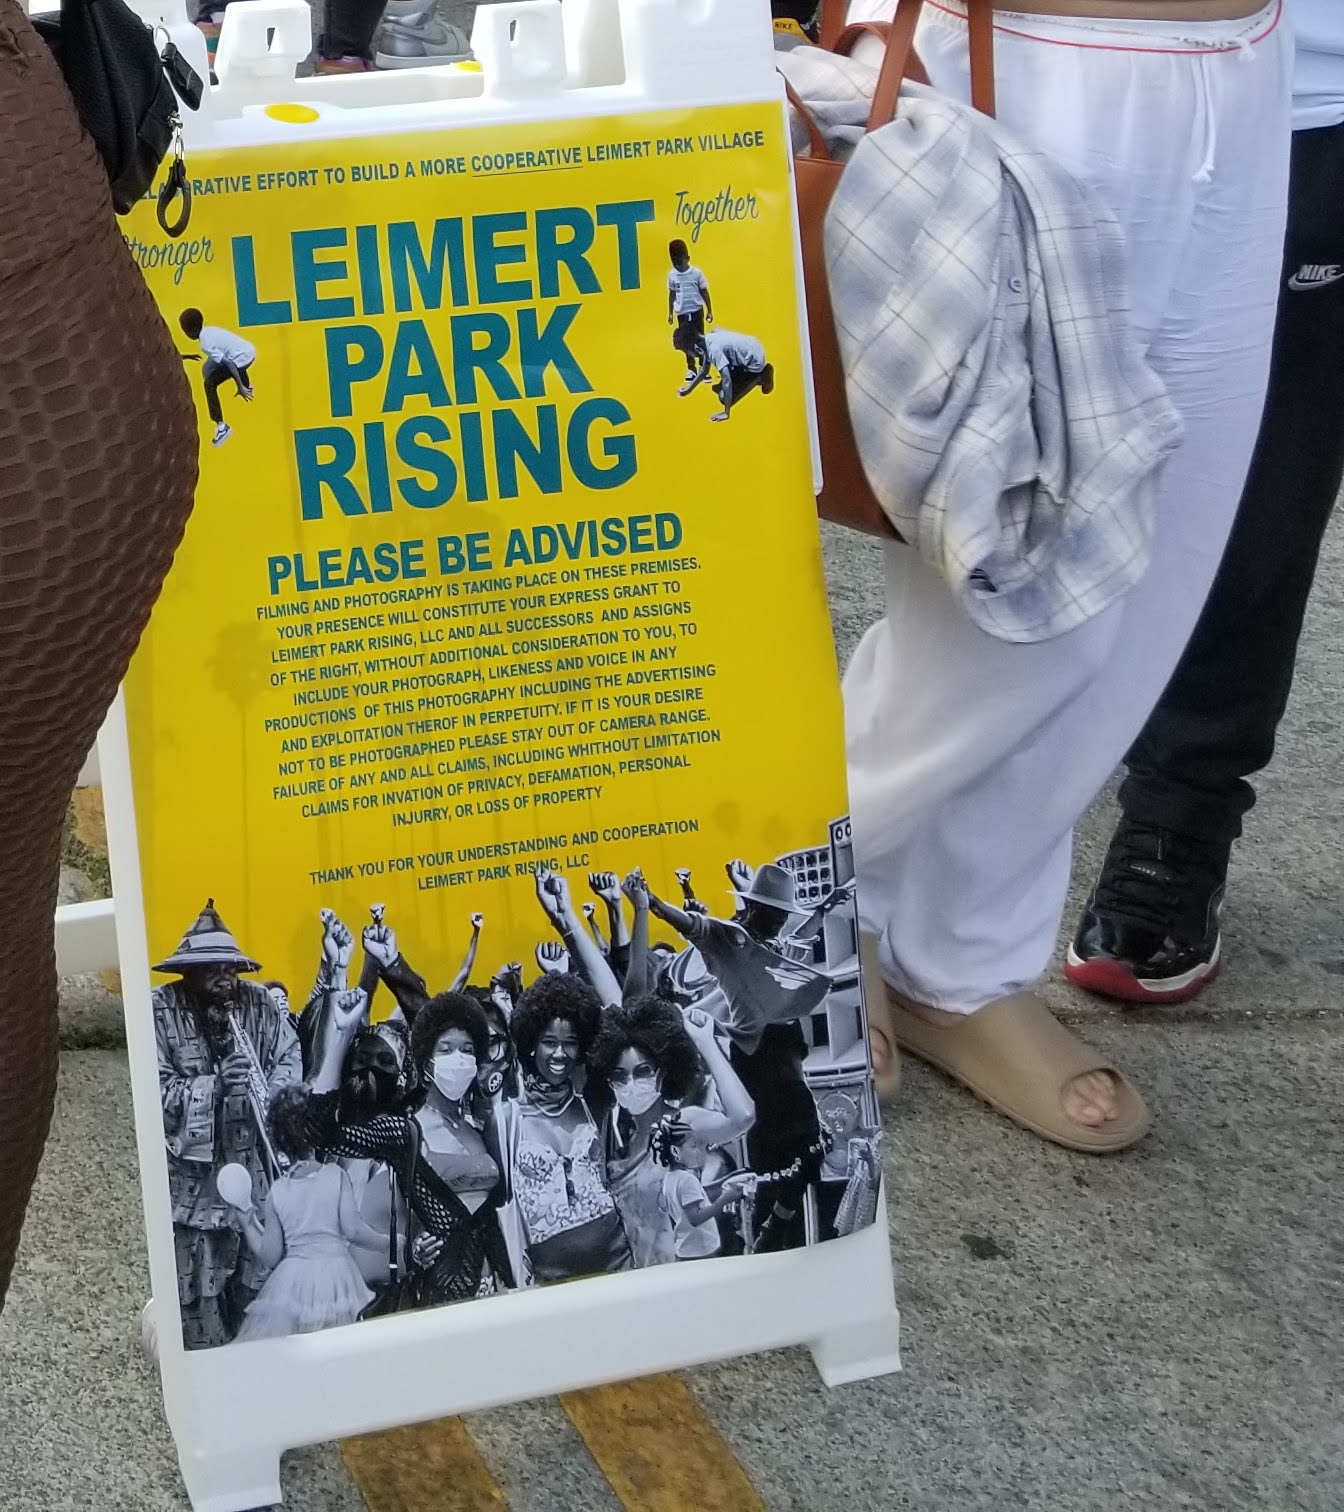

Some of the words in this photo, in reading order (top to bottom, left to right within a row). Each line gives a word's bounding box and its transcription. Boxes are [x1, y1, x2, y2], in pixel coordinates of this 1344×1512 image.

[256, 169, 318, 190] EFFORT
[323, 167, 345, 184] TO
[350, 162, 399, 182] BUILD
[404, 161, 415, 177] A
[420, 156, 466, 176] MORE
[471, 146, 582, 171] COOPERATIVE
[586, 140, 650, 162] LEIMERT
[656, 136, 694, 155] PARK
[697, 130, 764, 151] VILLAGE
[674, 185, 759, 244] Together
[231, 199, 655, 327] LEIMERT
[1297, 264, 1341, 280] NIKE
[324, 303, 594, 417] PARK
[293, 397, 637, 520] RISING
[267, 539, 426, 595] PLEASE
[437, 531, 492, 575] BE
[503, 512, 682, 567] ADVISED
[256, 601, 309, 620] FILMING
[313, 597, 339, 612] AND
[344, 585, 442, 608] PHOTOGRAPHY
[446, 583, 459, 596] IS
[462, 577, 512, 594] TAKING
[515, 571, 557, 588] PLACE
[560, 568, 580, 582] ON
[582, 564, 626, 580] THESE
[630, 556, 701, 575] PREMISES.
[276, 623, 313, 639] YOUR
[316, 613, 384, 634] PRESENCE
[387, 610, 420, 625] WILL
[422, 599, 506, 621] CONSTITUTE
[509, 594, 546, 610] YOUR
[549, 587, 609, 606] EXPRESS
[612, 582, 658, 599] GRANT
[662, 580, 680, 593] TO
[270, 671, 286, 686] OF
[289, 667, 316, 683] THE
[319, 661, 361, 679] RIGHT,
[364, 653, 425, 673] WITHOUT
[429, 643, 508, 664] ADDITIONAL
[511, 630, 618, 654] CONSIDERATION
[621, 628, 640, 641] TO
[643, 624, 676, 639] YOU,
[678, 622, 697, 635] TO
[271, 643, 326, 663] LEIMERT
[330, 638, 364, 655] PARK
[368, 632, 416, 649] RISING,
[419, 628, 444, 643] LLC
[448, 625, 474, 640] AND
[478, 622, 502, 636] ALL
[506, 611, 593, 633] SUCCESSORS
[601, 607, 628, 621] AND
[633, 600, 691, 618] ASSIGNS
[264, 707, 356, 732] PRODUCTIONS
[363, 703, 379, 717] OF
[383, 699, 414, 715] THIS
[417, 686, 514, 710] PHOTOGRAPHY
[519, 676, 591, 697] INCLUDING
[594, 673, 622, 688] THE
[626, 663, 715, 685] ADVERTISING
[293, 685, 349, 705] INCLUDE
[351, 680, 389, 697] YOUR
[391, 668, 484, 691] PHOTOGRAPH,
[488, 659, 552, 679] LIKENESS
[556, 656, 583, 671] AND
[586, 651, 628, 667] VOICE
[631, 649, 645, 662] IN
[649, 645, 676, 661] ANY
[278, 759, 304, 776] NOT
[307, 756, 325, 770] TO
[329, 753, 346, 768] BE
[349, 739, 455, 765] PHOTOGRAPHED
[458, 731, 508, 750] PLEASE
[511, 727, 543, 743] STAY
[547, 723, 574, 738] OUT
[578, 720, 595, 734] OF
[599, 714, 656, 731] CAMERA
[659, 709, 710, 725] RANGE.
[281, 737, 307, 753] AND
[310, 723, 403, 748] EXPLOITATION
[405, 715, 458, 734] THEROF
[462, 713, 475, 727] IN
[479, 702, 562, 725] PERPETUITY.
[565, 700, 577, 714] IF
[581, 698, 593, 712] IT
[597, 697, 610, 710] IS
[613, 693, 650, 707] YOUR
[654, 687, 703, 703] DESIRE
[272, 779, 325, 799] FAILURE
[328, 776, 344, 790] OF
[349, 771, 374, 787] ANY
[379, 767, 406, 783] AND
[410, 763, 434, 779] ALL
[437, 756, 489, 775] CLAIMS,
[492, 746, 564, 767] INCLUDING
[567, 737, 639, 757] WHITHOUT
[643, 728, 720, 748] LIMITATION
[301, 798, 349, 817] CLAIMS
[352, 794, 378, 810] FOR
[382, 784, 443, 805] INVATION
[446, 782, 463, 796] OF
[467, 774, 524, 793] PRIVACY,
[527, 762, 615, 785] DEFAMATION,
[618, 754, 691, 773] PERSONAL
[392, 806, 451, 826] INJURRY,
[454, 803, 473, 817] OR
[476, 798, 509, 814] LOSS
[513, 795, 529, 809] OF
[533, 785, 602, 806] PROPERTY
[308, 865, 354, 884] THANK
[356, 860, 384, 876] YOU
[388, 856, 414, 872] FOR
[416, 851, 454, 867] YOUR
[457, 834, 567, 862] UNDERSTANDING
[572, 830, 598, 845] AND
[602, 818, 698, 841] COOPERATION
[418, 870, 473, 890] LEIMERT
[477, 864, 511, 881] PARK
[566, 853, 589, 868] LLC
